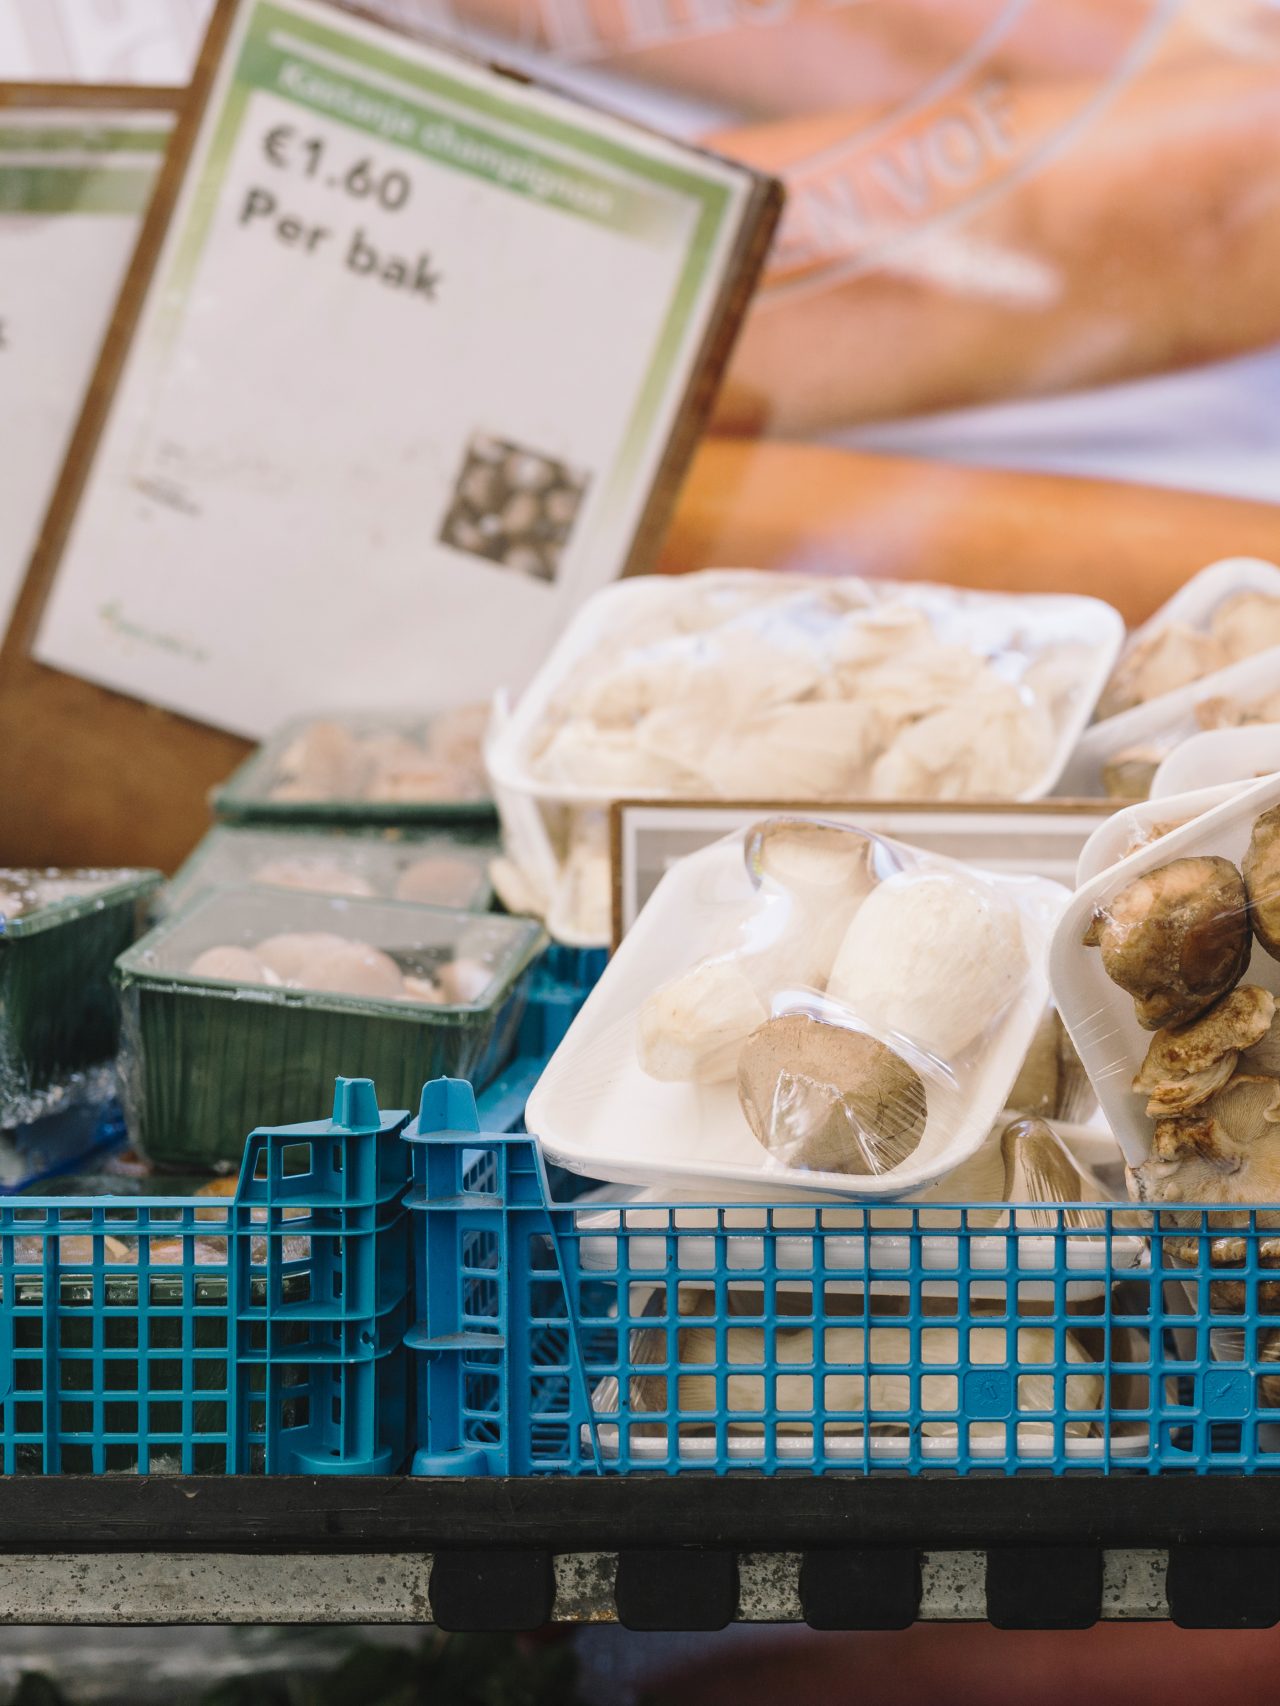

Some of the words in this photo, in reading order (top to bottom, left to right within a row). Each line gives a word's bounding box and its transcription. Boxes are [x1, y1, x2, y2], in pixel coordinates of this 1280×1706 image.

[263, 124, 412, 213] €1.60
[239, 184, 330, 253] Per
[345, 227, 441, 303] bak
